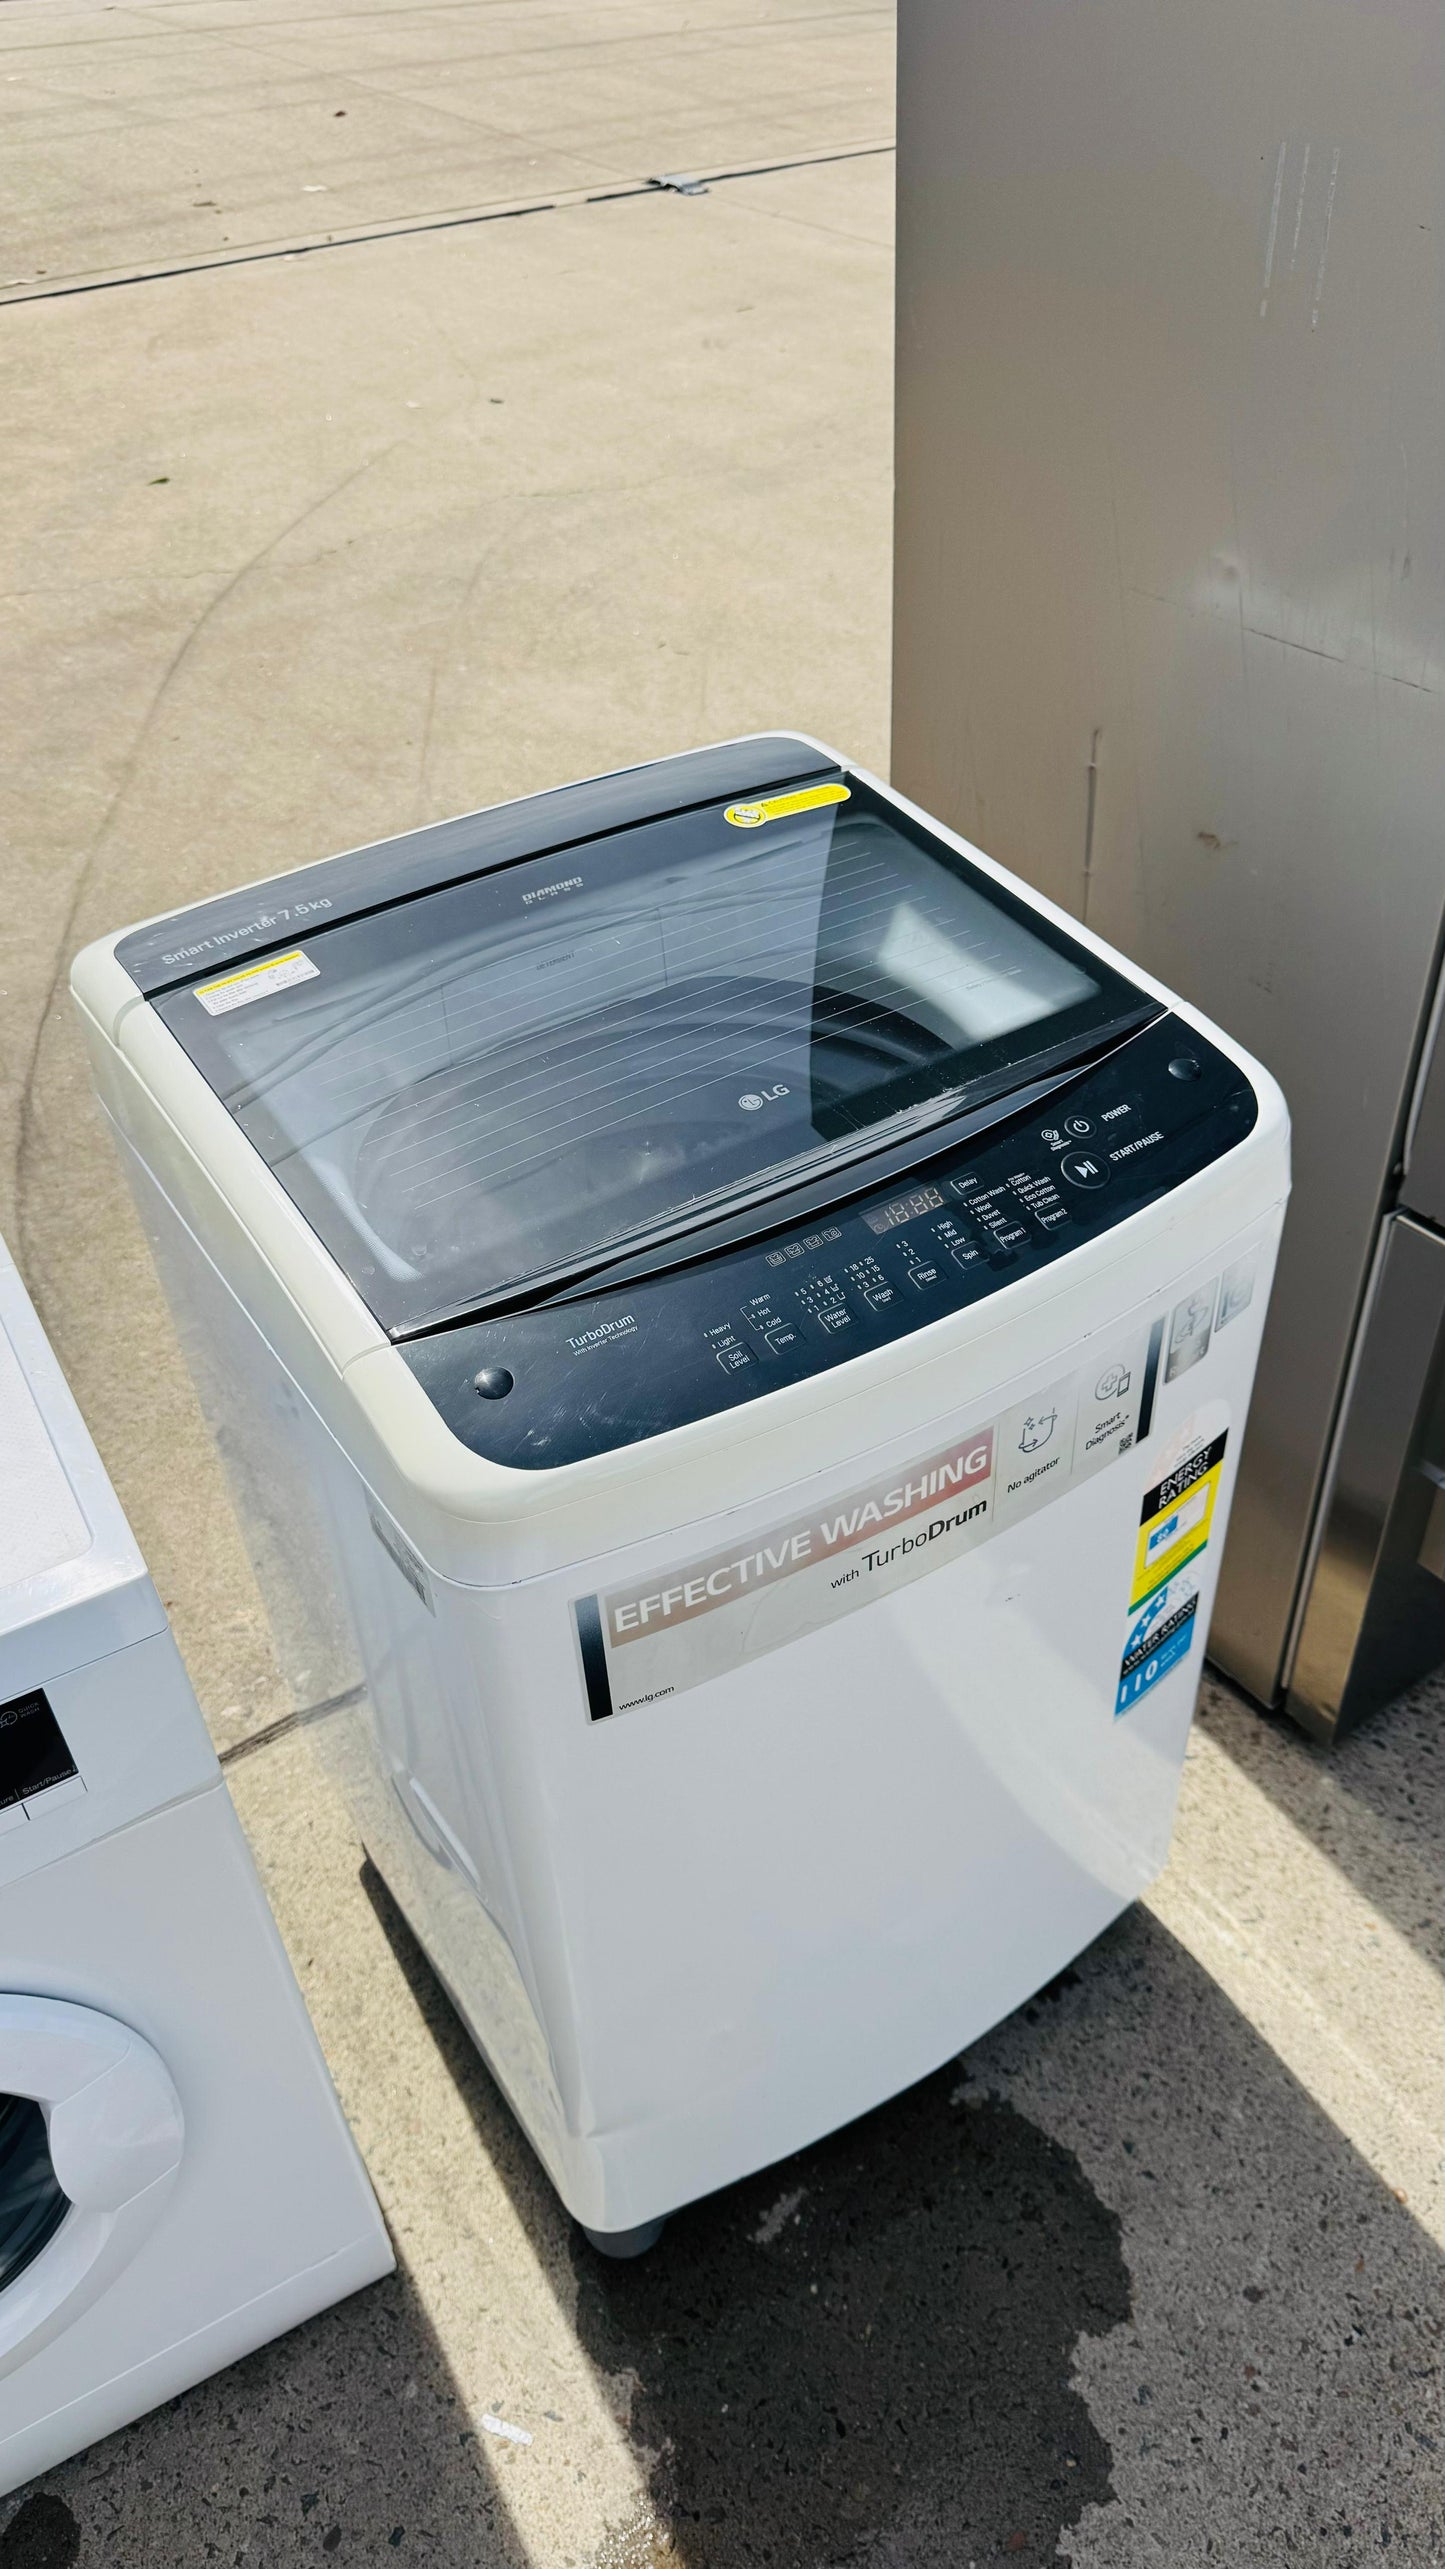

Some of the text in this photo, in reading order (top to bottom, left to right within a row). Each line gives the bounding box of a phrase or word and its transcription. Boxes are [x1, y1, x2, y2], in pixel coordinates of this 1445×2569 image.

[522, 876, 583, 901] DIAMOND
[162, 939, 215, 965] Smart
[213, 915, 279, 945] Inverter
[761, 1084, 790, 1101] LG
[1101, 1104, 1132, 1122] POWER
[1109, 1131, 1165, 1162] START/PAUSE
[958, 1176, 978, 1189] Delay
[1010, 1174, 1032, 1187] Cotton
[1017, 1183, 1036, 1195] Quick
[1032, 1176, 1052, 1187] Wash
[968, 1186, 1006, 1206] Cotton Wash
[1023, 1184, 1056, 1202] Eco Cotton
[974, 1202, 993, 1213] Wool
[1030, 1193, 1061, 1209] Tub Clean
[981, 1209, 1001, 1221] Duvet
[937, 1220, 954, 1231] High
[988, 1217, 1007, 1229] Silent
[943, 1228, 958, 1239] Mid
[901, 1240, 909, 1248] 3
[950, 1236, 966, 1247] Low
[908, 1248, 916, 1256] 2
[962, 1249, 979, 1261] Spin
[849, 1256, 875, 1272] 18 25
[856, 1264, 881, 1280] 10 15
[917, 1268, 937, 1281] Rinse
[863, 1274, 885, 1289] 3 6
[749, 1293, 771, 1307] Warm
[807, 1288, 831, 1304] 3 4
[872, 1288, 894, 1302] Wash
[757, 1307, 772, 1318] Hot
[824, 1308, 848, 1323] Water
[709, 1322, 732, 1336] Heavy
[765, 1317, 782, 1329] Cold
[831, 1315, 852, 1329] Level
[565, 1315, 635, 1349] TurboDrum
[775, 1332, 797, 1346] Temp.
[573, 1325, 638, 1357] With Inverter Technology
[717, 1335, 736, 1348] Light
[728, 1350, 744, 1362] Soil
[729, 1355, 751, 1369] Level
[1095, 1412, 1121, 1434] Smart
[1007, 1457, 1060, 1493] No agitator
[1160, 1446, 1212, 1496] ENERGY
[1158, 1461, 1208, 1509] RATING
[614, 1445, 987, 1633] EFFECTIVE WASHING
[830, 1500, 987, 1589] with TurboDrum
[619, 1686, 675, 1710] www.lg.com
[22, 1769, 72, 1795] Start/Pause
